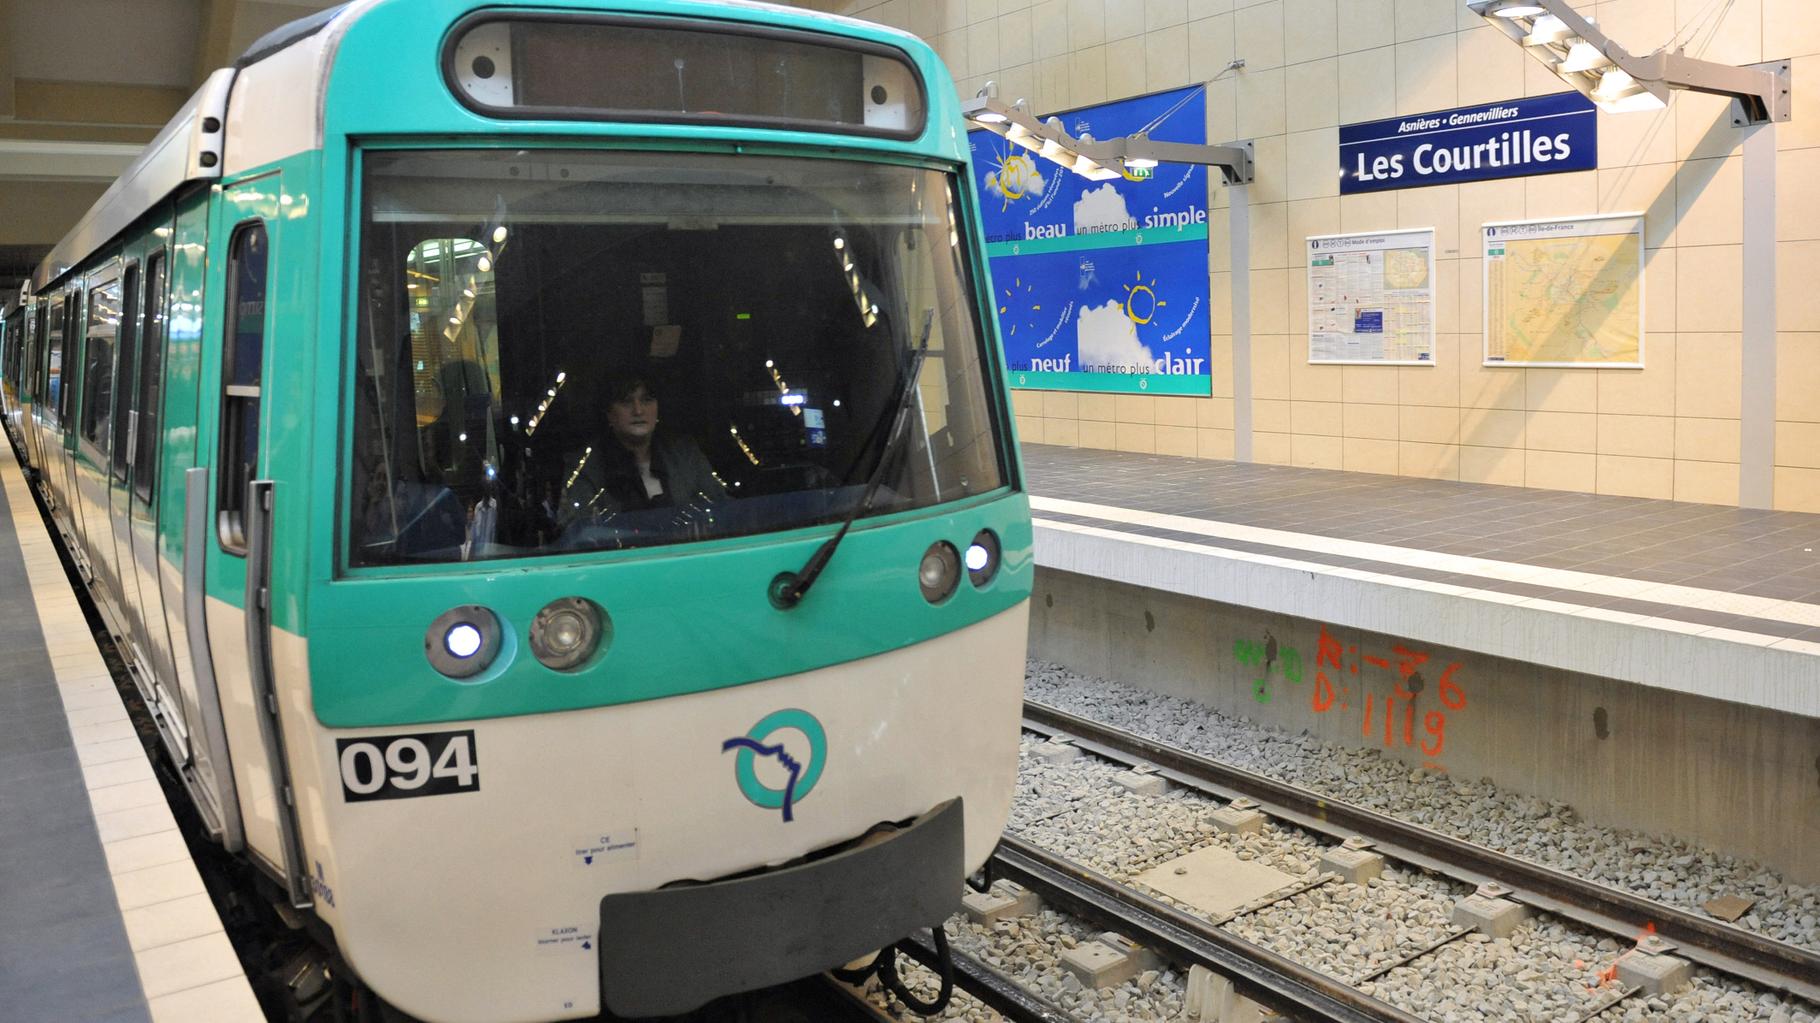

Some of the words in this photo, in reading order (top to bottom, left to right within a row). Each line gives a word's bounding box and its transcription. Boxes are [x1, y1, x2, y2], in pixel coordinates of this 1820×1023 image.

[1398, 119, 1440, 133] Asnières
[1449, 107, 1519, 125] Gennevilliers
[1357, 152, 1404, 181] Les
[1413, 130, 1571, 175] Courtilles
[1024, 221, 1066, 240] beau
[1077, 226, 1087, 235] un
[1090, 221, 1119, 233] métro
[1122, 217, 1141, 234] plus
[1145, 205, 1206, 232] simple
[1012, 361, 1027, 375] plus
[1031, 353, 1071, 372] neuf
[1083, 365, 1094, 374] un
[1098, 362, 1127, 374] métro
[1130, 362, 1150, 377] plus
[1155, 347, 1205, 375] clair
[340, 735, 478, 795] 094
[552, 927, 578, 935] KLAXON
